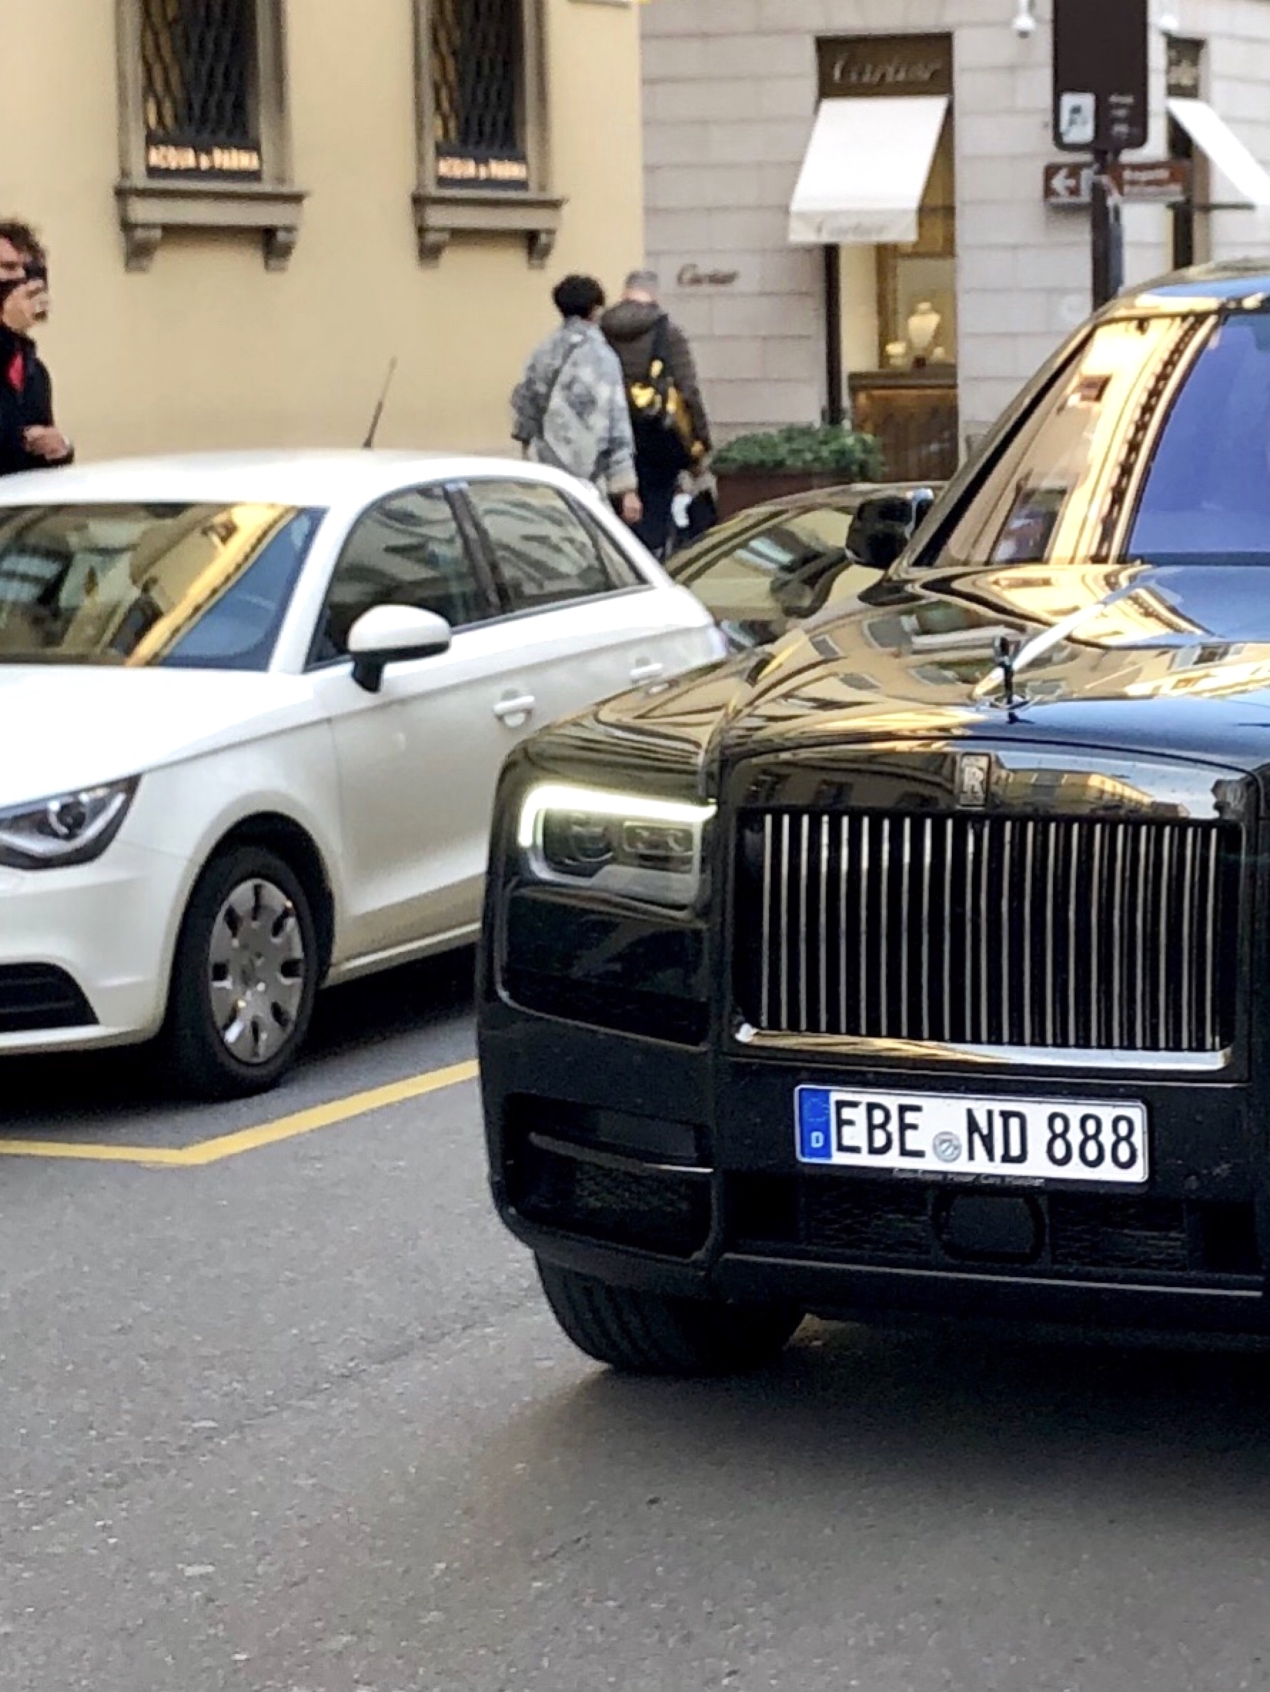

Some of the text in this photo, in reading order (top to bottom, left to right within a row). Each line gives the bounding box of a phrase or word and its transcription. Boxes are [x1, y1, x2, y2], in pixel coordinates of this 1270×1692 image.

[810, 1131, 825, 1149] D
[834, 1099, 1138, 1170] EBE ND 888
